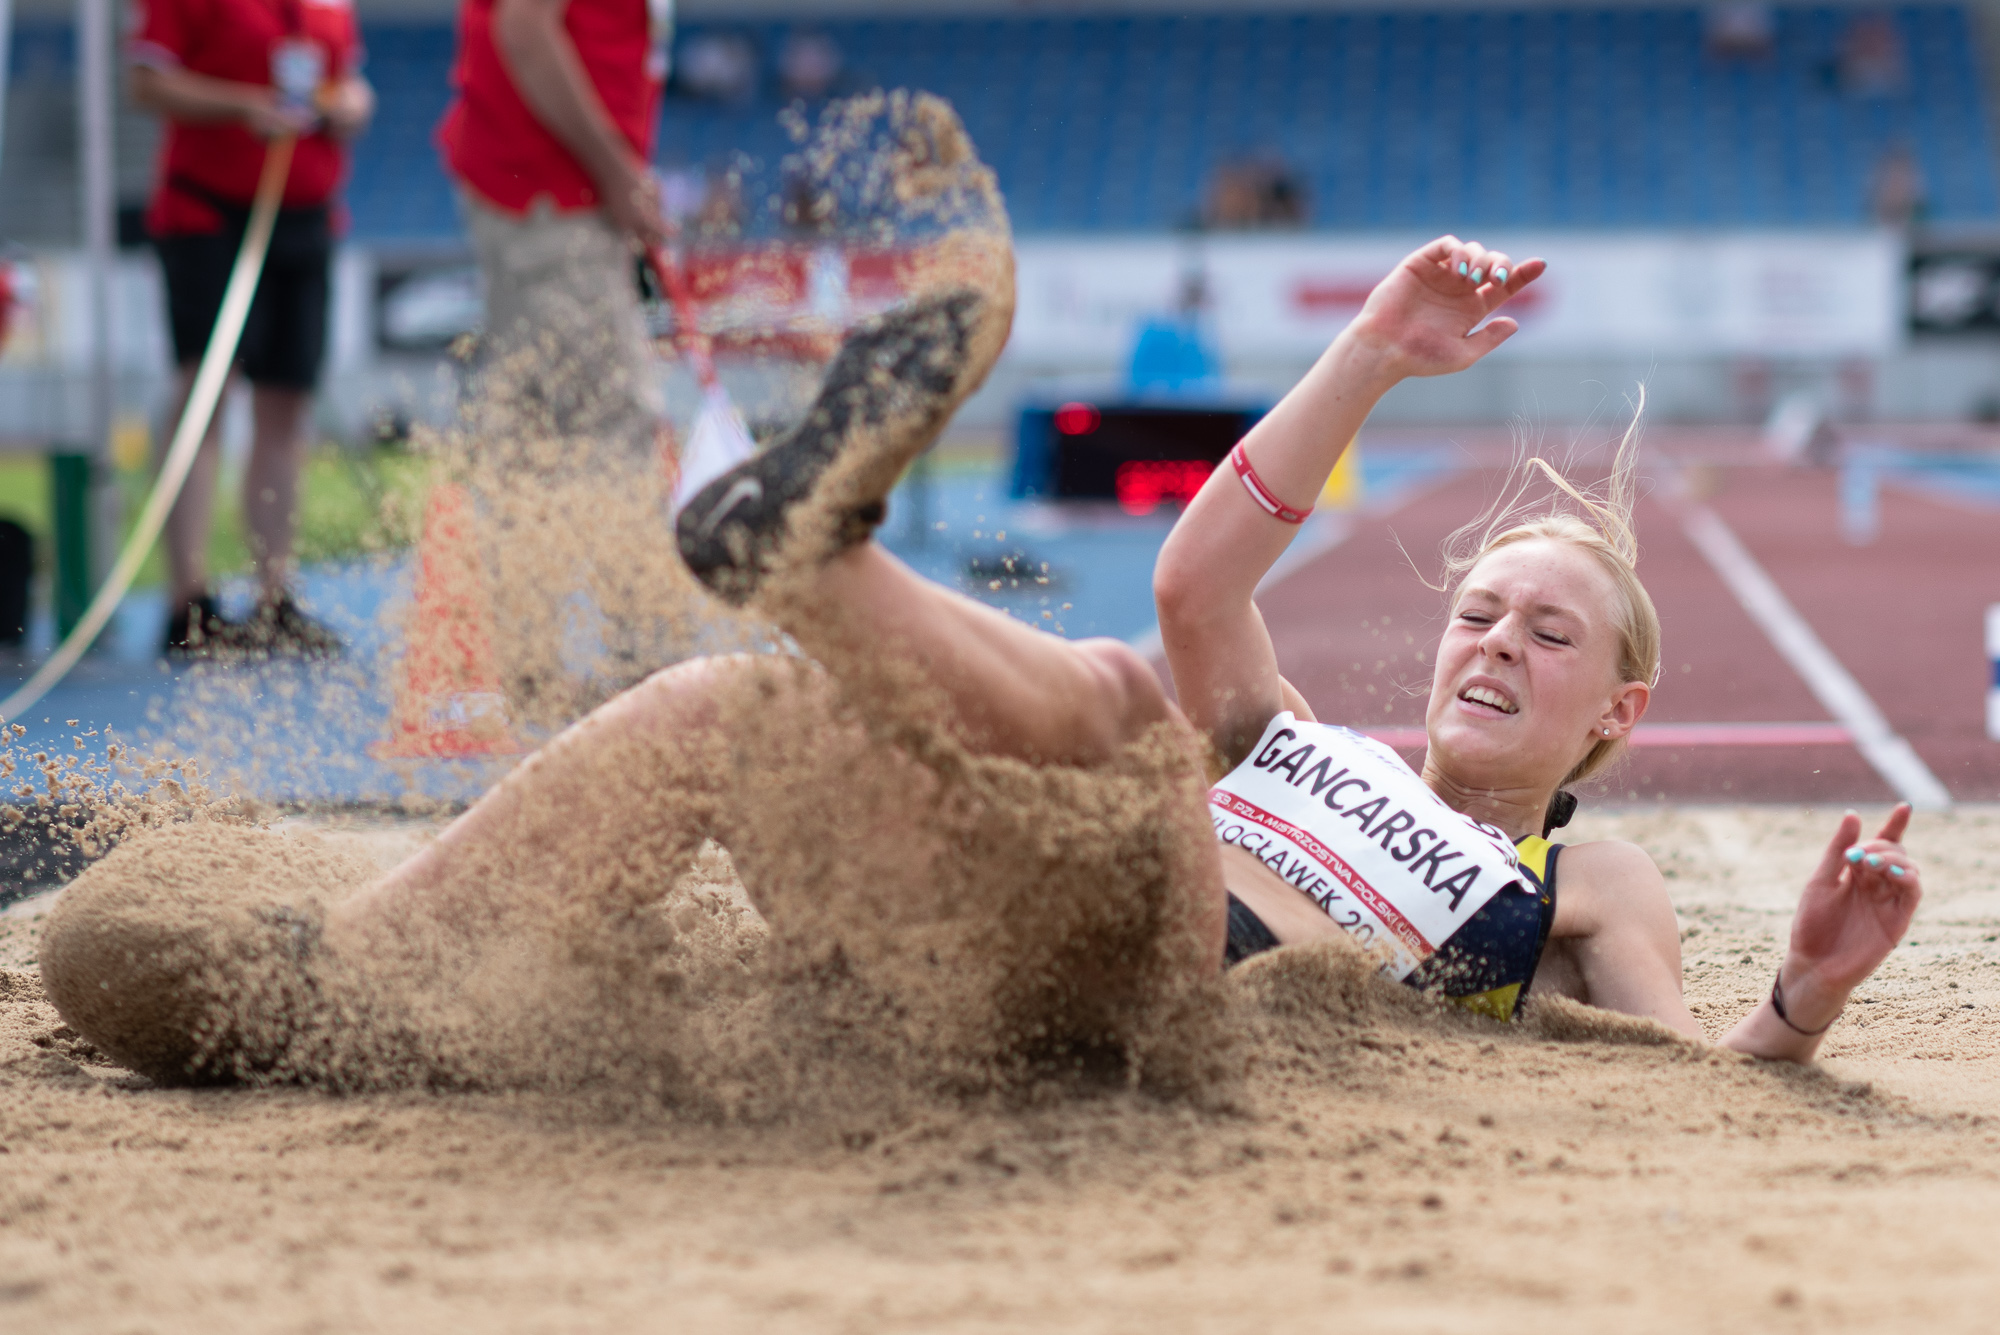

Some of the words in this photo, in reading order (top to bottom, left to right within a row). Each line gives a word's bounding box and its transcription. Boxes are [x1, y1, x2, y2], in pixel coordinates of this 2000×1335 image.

[1233, 801, 1265, 822] PZLA
[1264, 817, 1352, 884] MISTRZOSTWA
[1352, 879, 1399, 923] POLSKI
[1253, 728, 1482, 913] GANCARSKA
